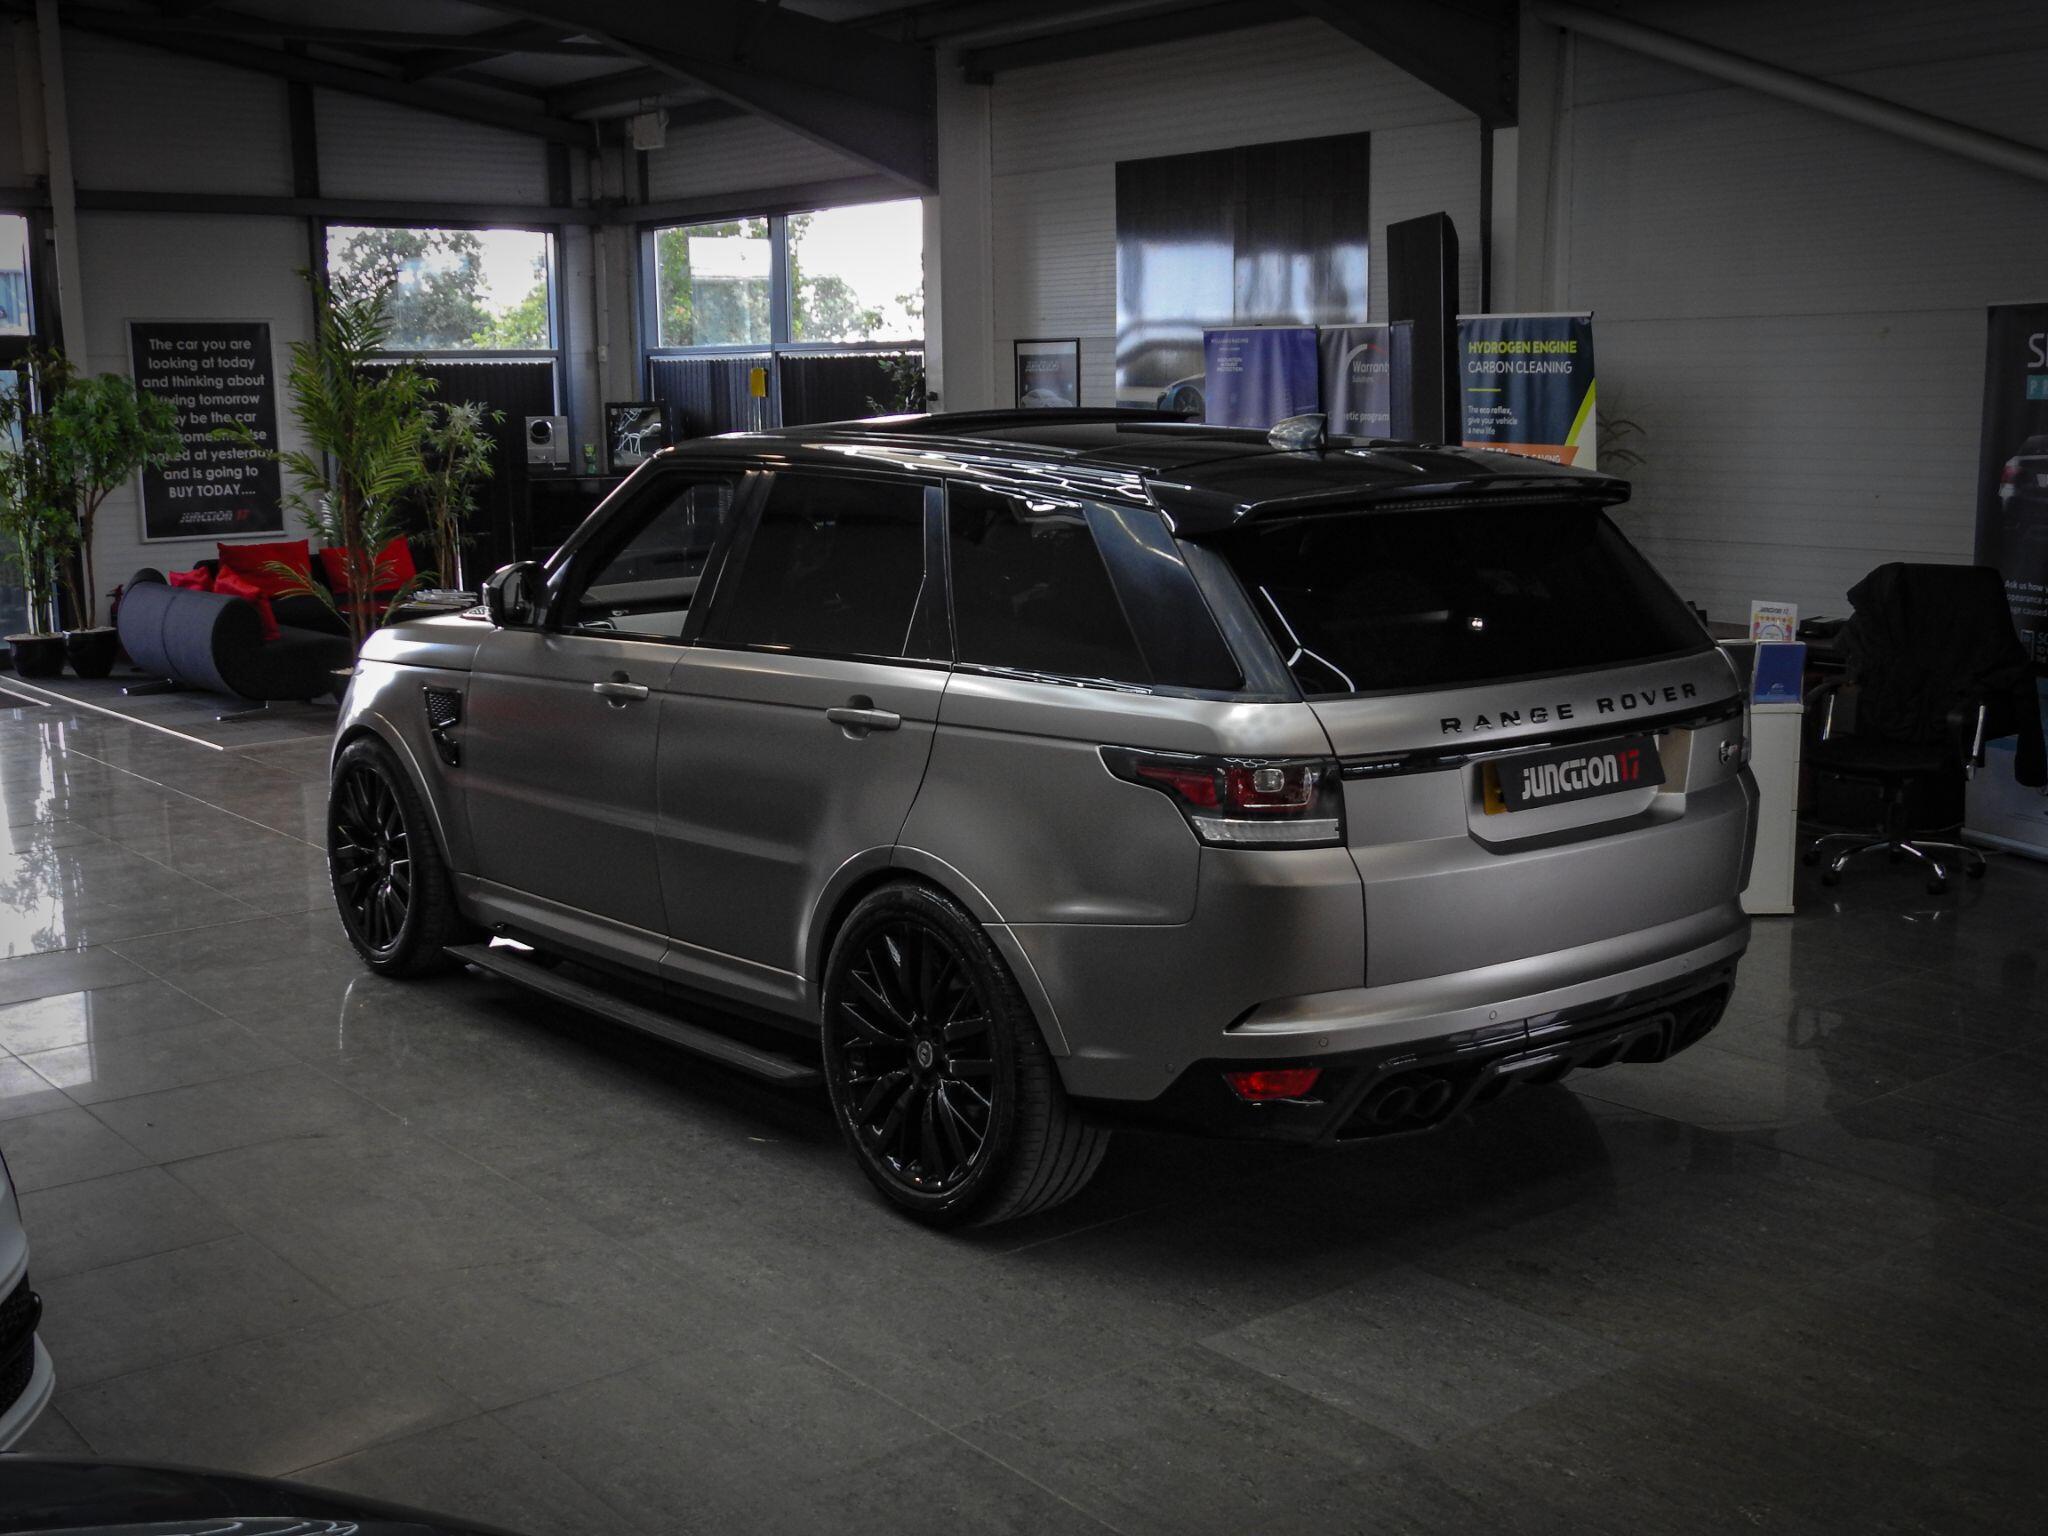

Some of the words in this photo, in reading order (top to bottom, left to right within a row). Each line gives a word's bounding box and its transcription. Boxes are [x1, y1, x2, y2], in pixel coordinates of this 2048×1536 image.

[148, 338, 173, 350] The
[176, 340, 198, 350] car
[201, 340, 226, 352] you
[229, 339, 252, 349] are
[1468, 341, 1533, 354] HYDROGEN
[1533, 340, 1578, 353] ENGINE
[148, 358, 198, 371] looking
[201, 358, 215, 368] at
[218, 357, 255, 370] today
[1468, 361, 1514, 374] CARBON
[1516, 360, 1573, 374] CLEANING
[142, 377, 168, 388] and
[172, 376, 224, 389] thinking
[227, 374, 265, 386] about
[199, 393, 260, 405] tomorrow
[190, 412, 208, 424] be
[210, 411, 232, 423] the
[235, 413, 256, 423] car
[194, 449, 207, 460] at
[211, 448, 273, 462] yesterday
[163, 469, 189, 481] and
[192, 468, 202, 479] is
[206, 467, 242, 481] going
[246, 466, 258, 477] to
[169, 486, 193, 498] BUY
[1440, 703, 1574, 734] RANGE
[1596, 683, 1697, 714] ROVER
